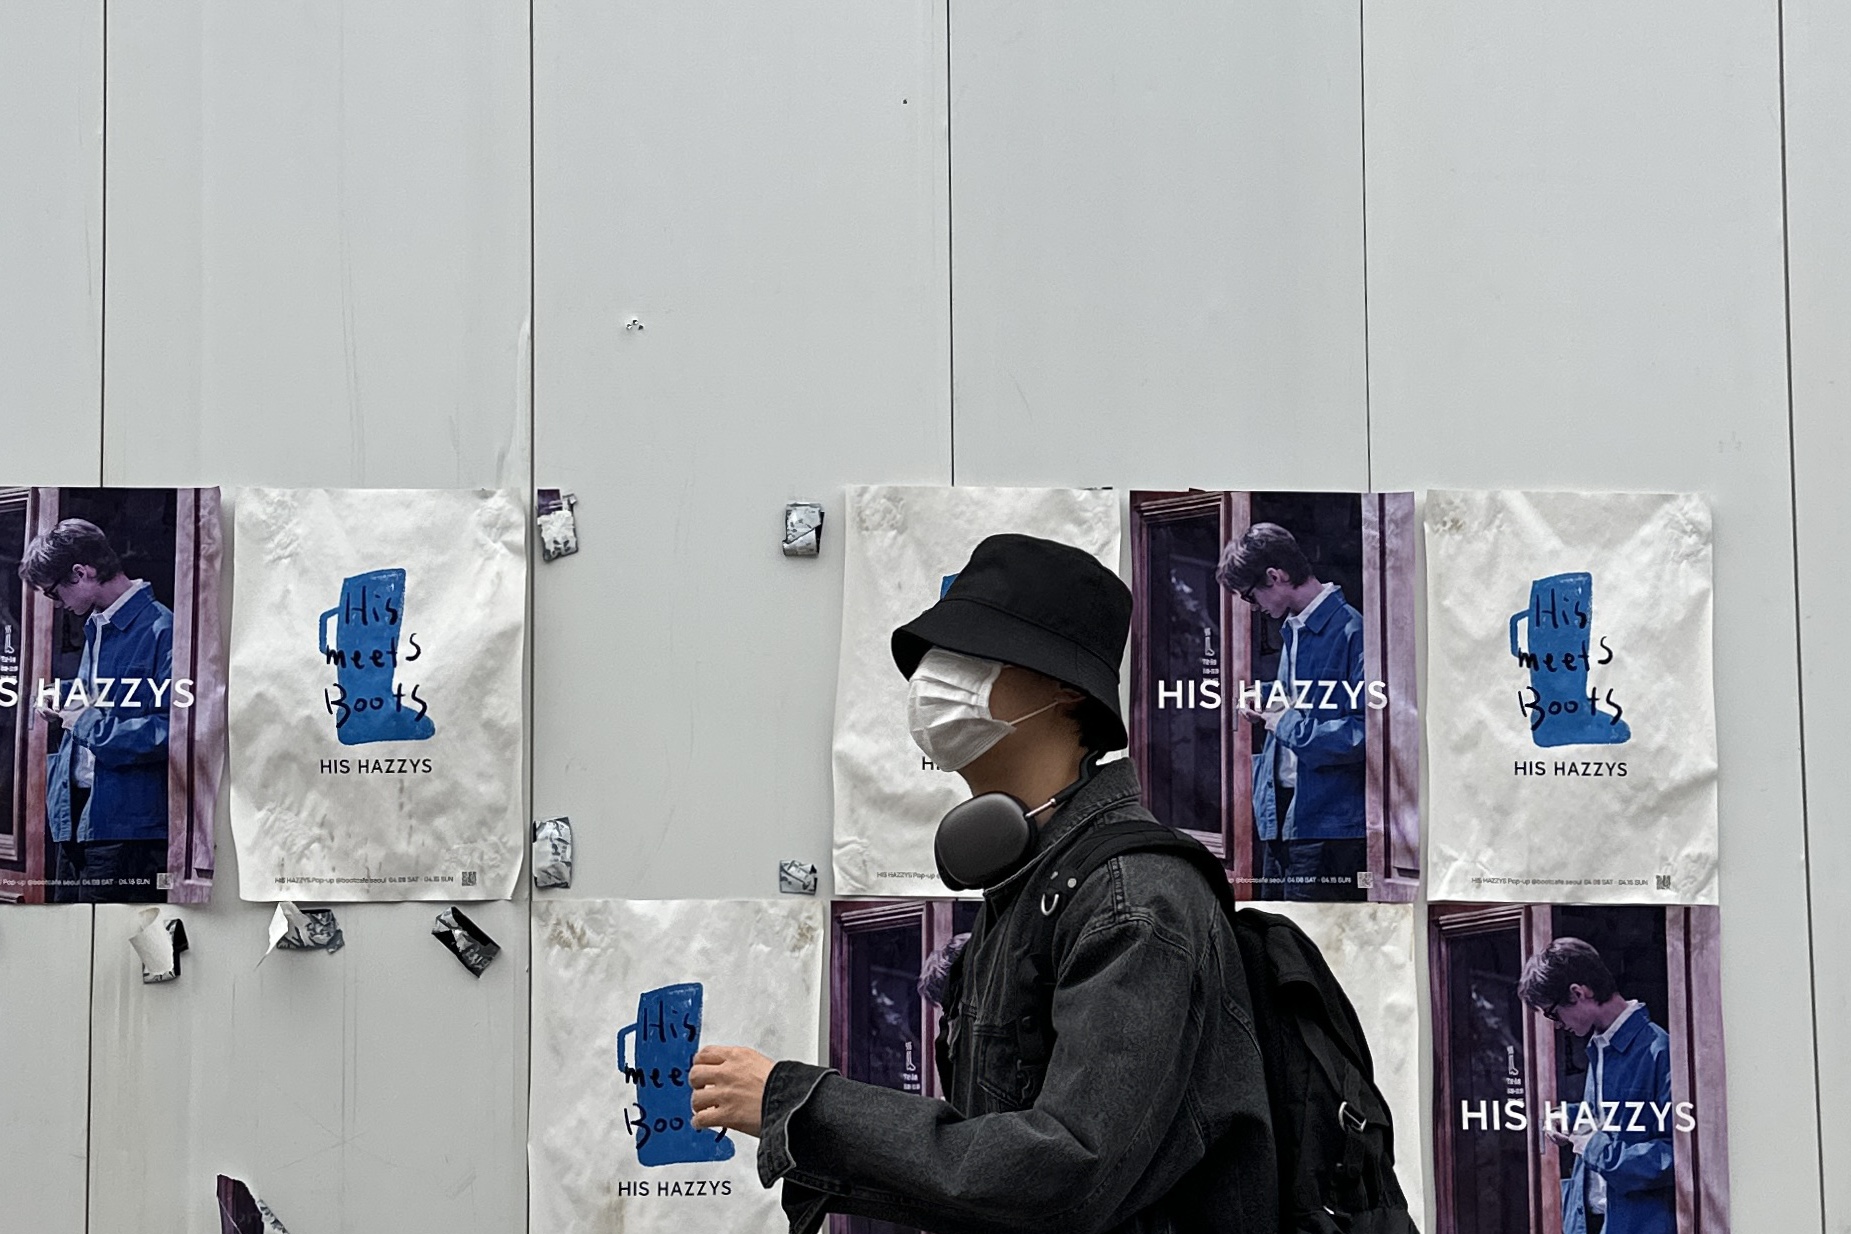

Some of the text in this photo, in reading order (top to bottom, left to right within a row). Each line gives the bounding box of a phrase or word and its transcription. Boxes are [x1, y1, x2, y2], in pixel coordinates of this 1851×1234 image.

[344, 585, 399, 626] His
[1535, 588, 1587, 629] His
[326, 633, 422, 669] meets
[1517, 636, 1613, 672] meets
[37, 677, 195, 709] HAZZYS
[324, 682, 428, 729] Boots
[1157, 679, 1389, 710] HIS HAZZYS
[1517, 686, 1623, 731] Boots
[320, 758, 433, 775] HIS HAZZYS
[1514, 760, 1628, 777] HIS HAZZYS
[642, 1000, 697, 1043] His
[624, 1053, 695, 1089] mee
[1461, 1100, 1696, 1133] HIS HAZZYS
[618, 1180, 732, 1197] HIS HAZZYS
